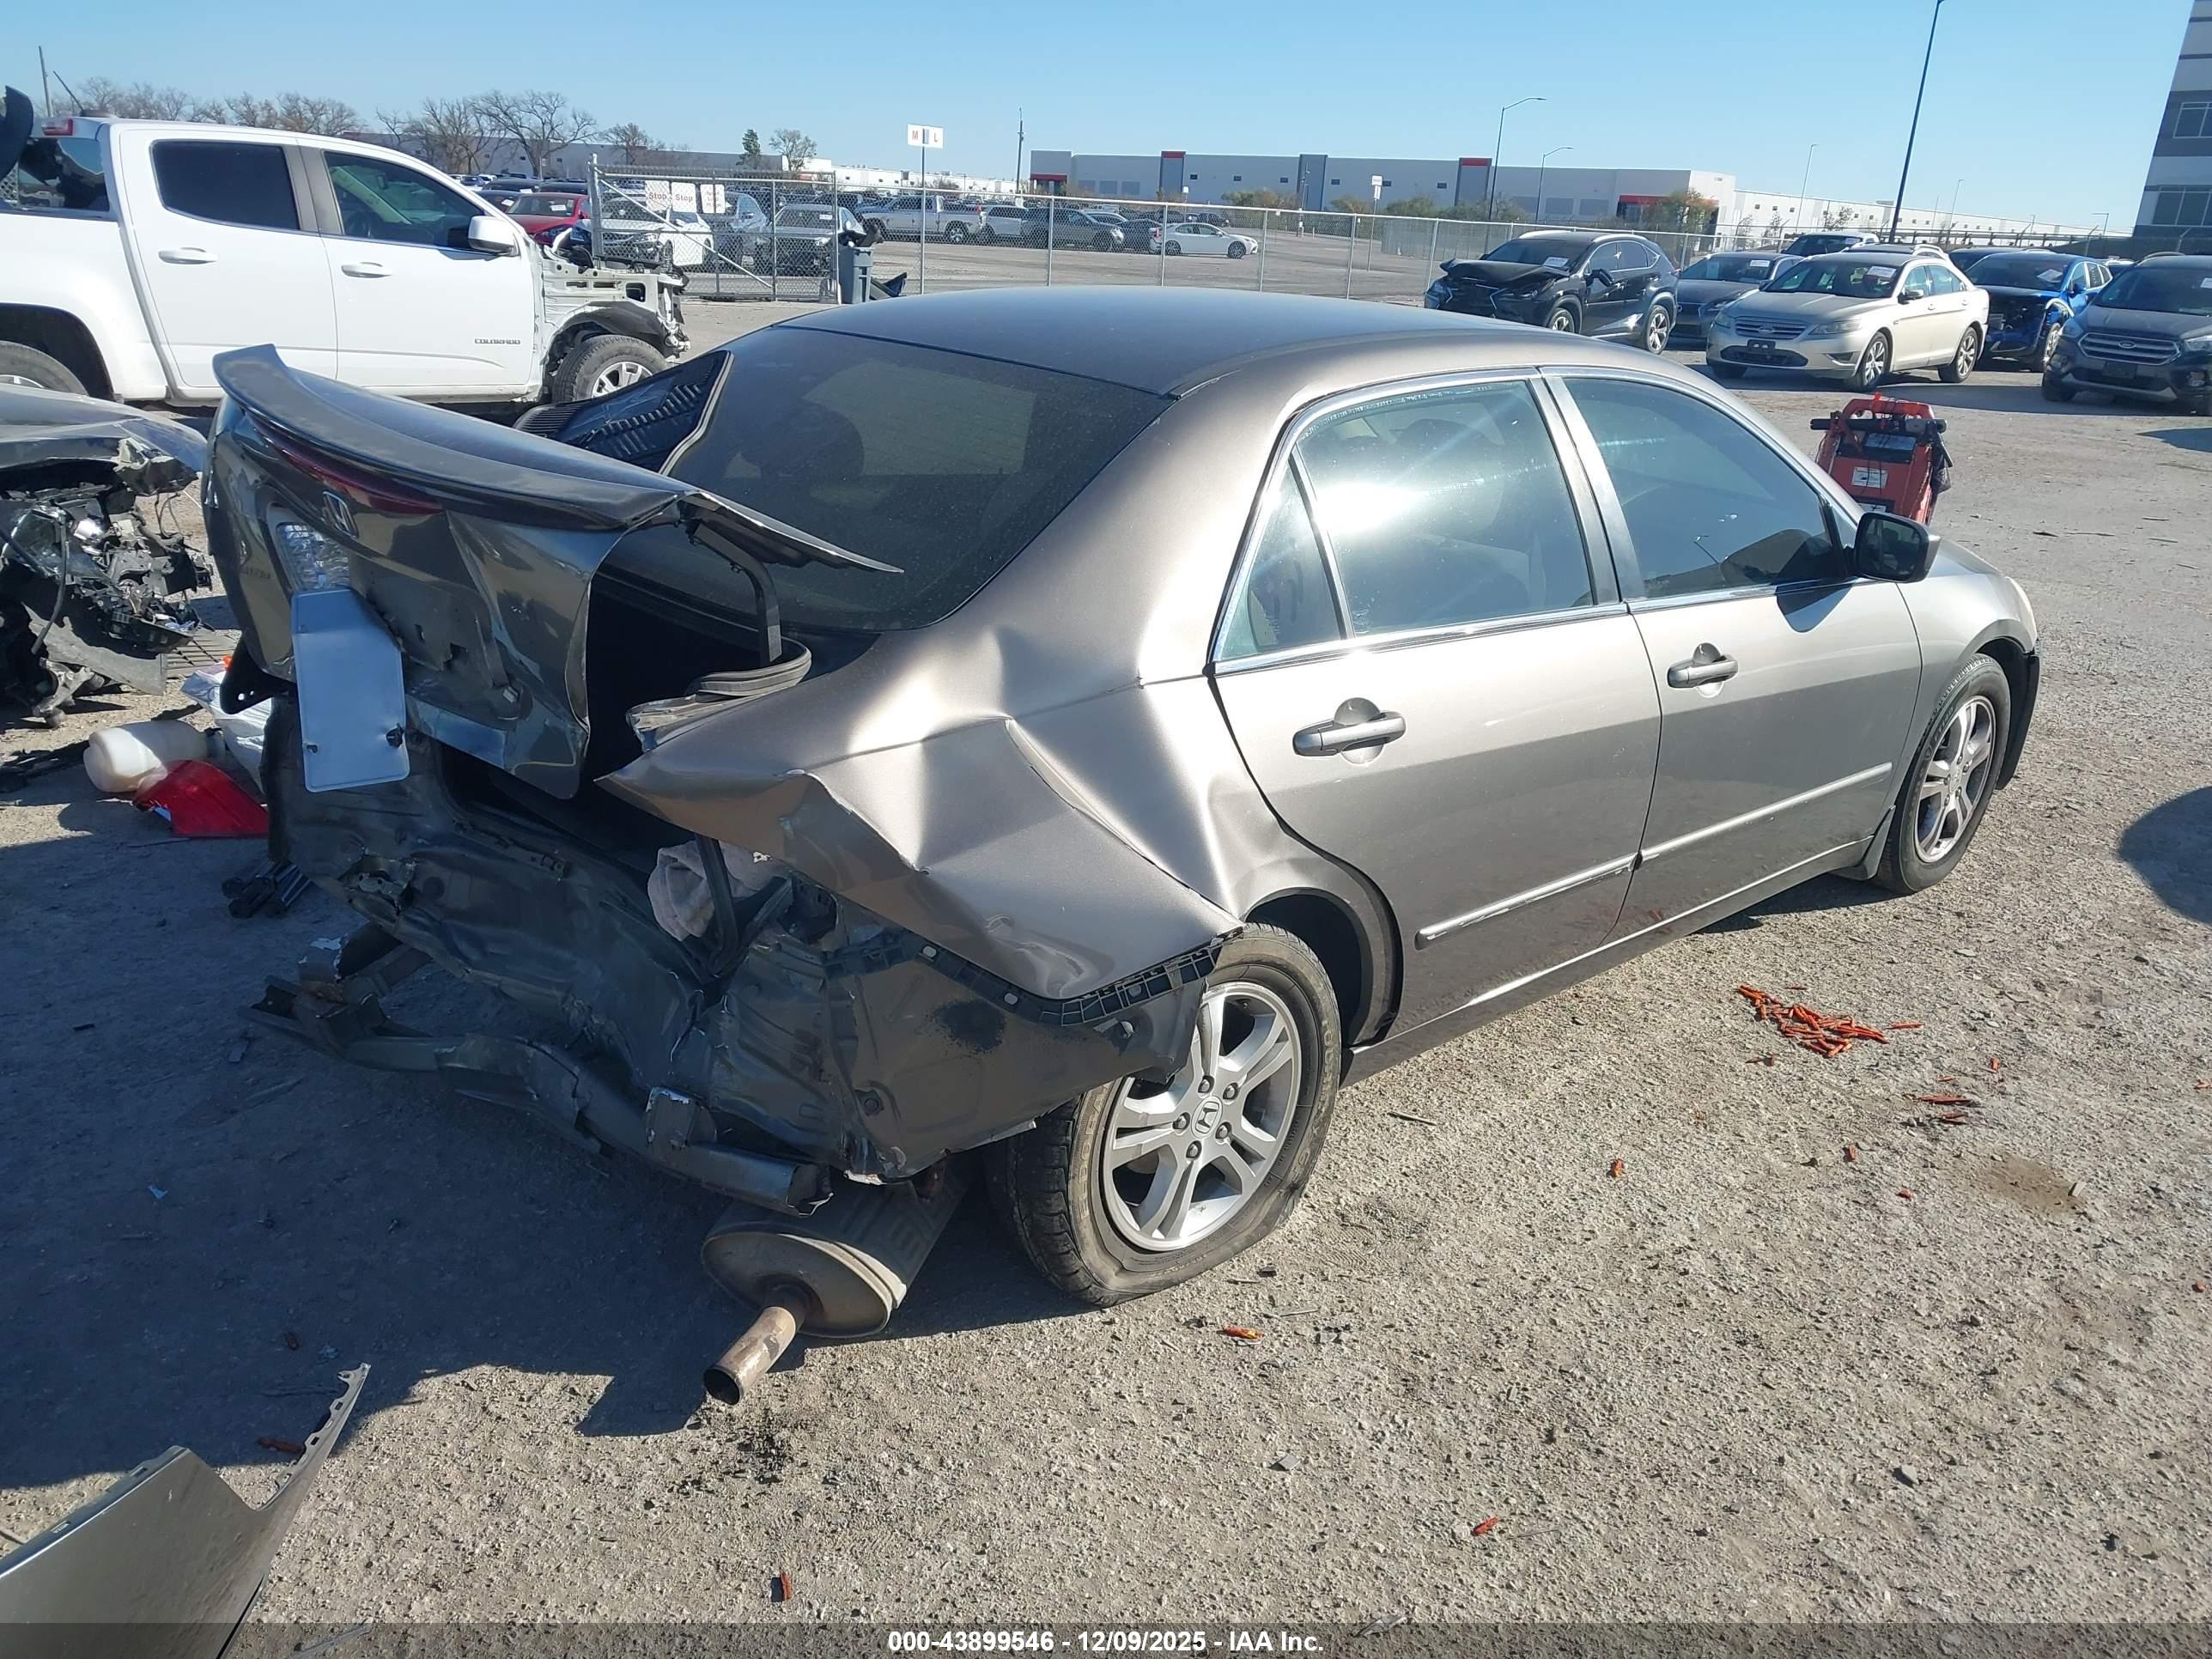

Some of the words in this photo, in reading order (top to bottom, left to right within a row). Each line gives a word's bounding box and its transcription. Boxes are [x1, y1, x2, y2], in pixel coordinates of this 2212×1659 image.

[912, 130, 919, 141] M
[933, 131, 939, 143] L
[648, 191, 667, 201] Stop
[675, 193, 693, 203] Stop
